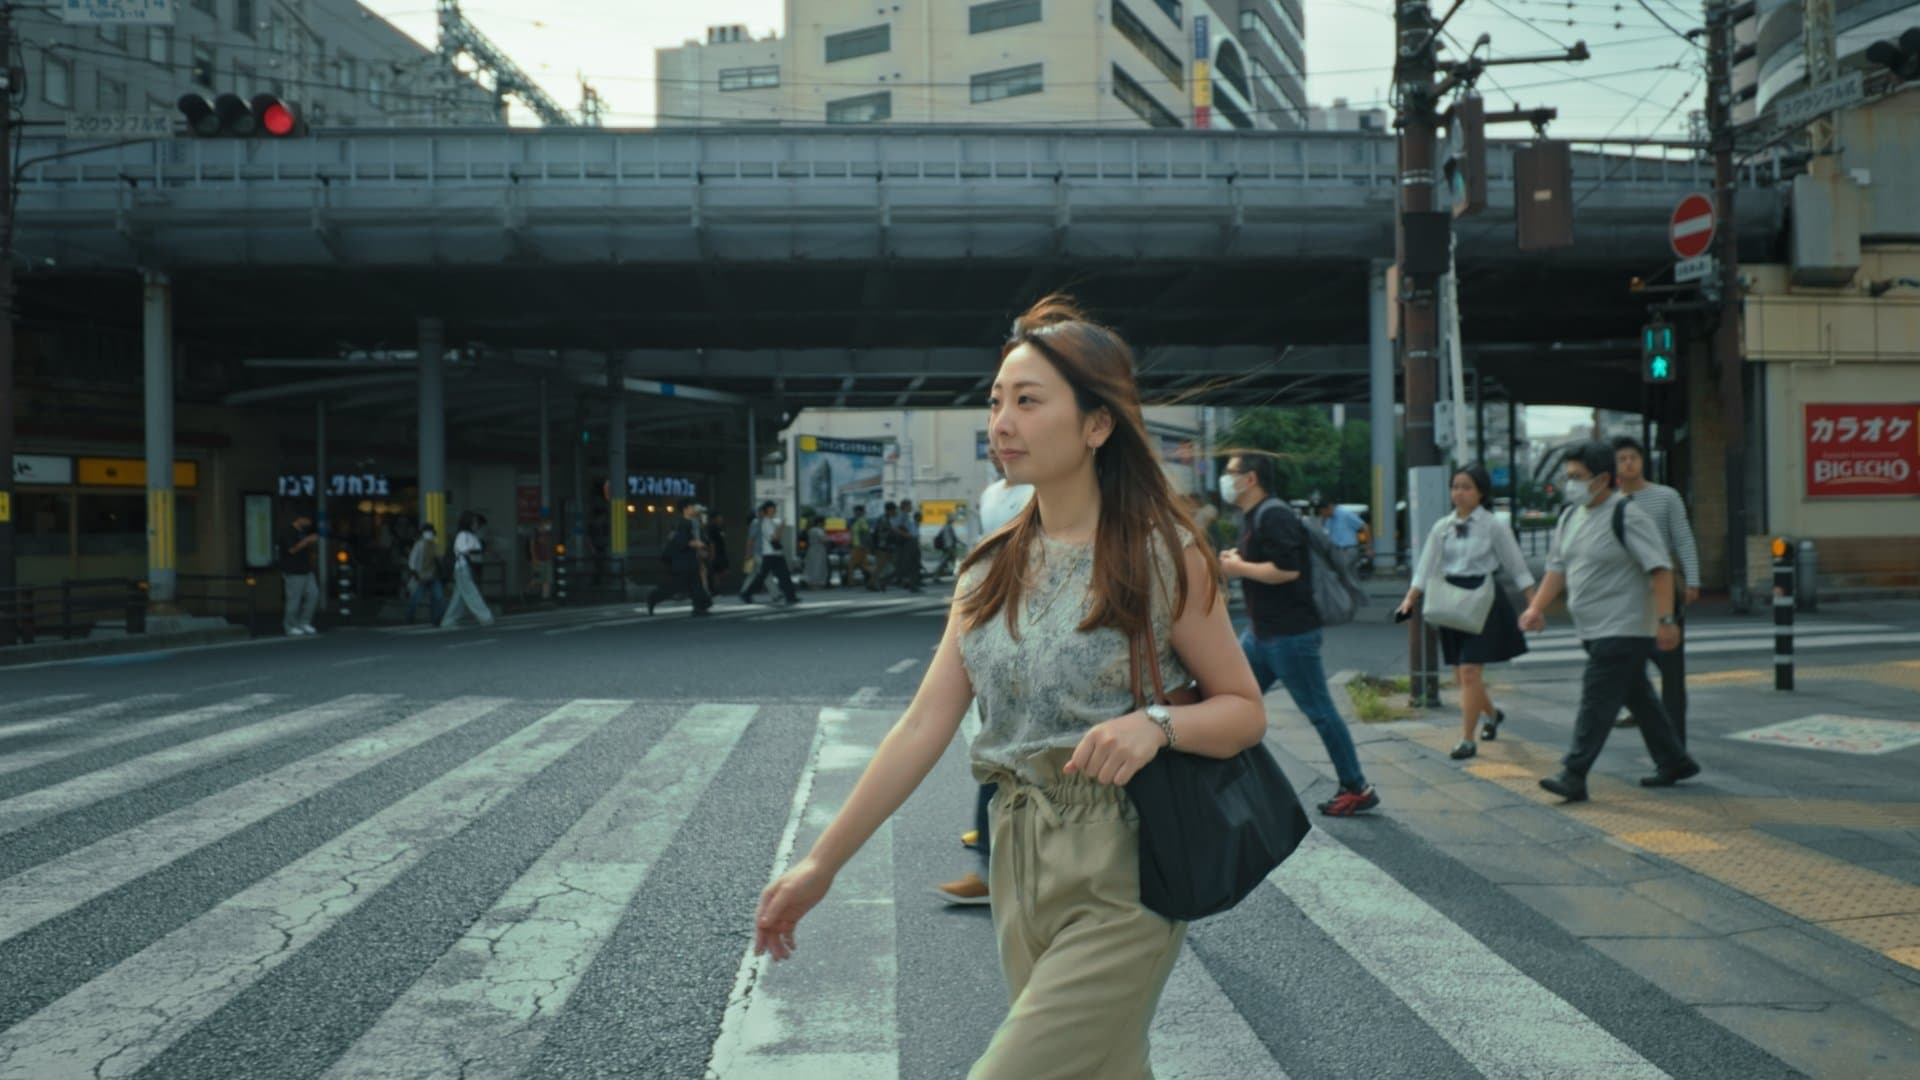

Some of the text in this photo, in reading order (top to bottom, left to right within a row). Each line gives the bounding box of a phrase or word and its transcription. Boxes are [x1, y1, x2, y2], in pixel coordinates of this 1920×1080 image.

[1811, 416, 1912, 443] カラオケ
[1814, 458, 1910, 483] BIG ECHO
[278, 474, 389, 497] ンマクカフェ
